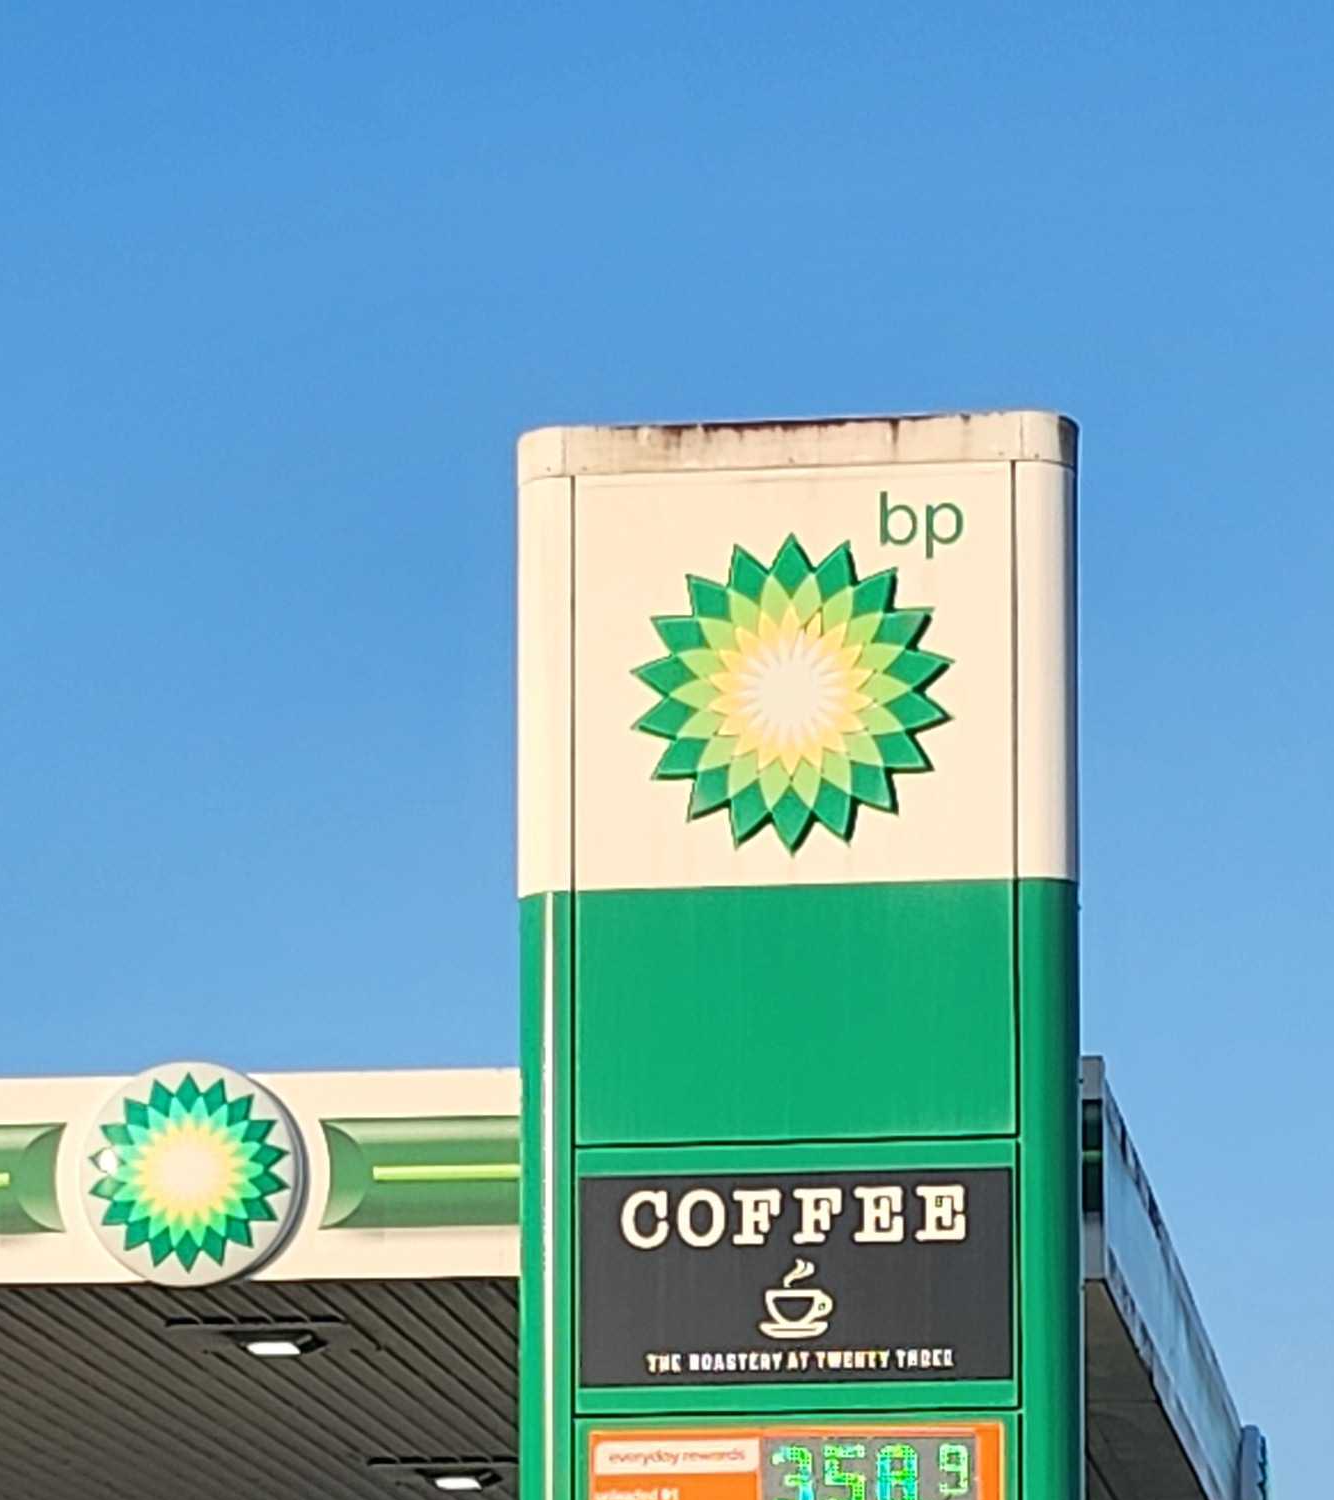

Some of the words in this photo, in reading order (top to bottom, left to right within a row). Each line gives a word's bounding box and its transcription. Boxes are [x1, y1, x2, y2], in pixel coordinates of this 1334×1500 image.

[879, 490, 964, 559] bp
[620, 1184, 968, 1250] COFFEE
[645, 1353, 682, 1375] THE
[688, 1351, 783, 1373] ROASTERY
[786, 1351, 809, 1372] AT
[815, 1349, 890, 1371] TWENTY
[896, 1348, 955, 1369] THREE
[608, 1449, 681, 1467] everyday
[683, 1448, 745, 1462] rewards
